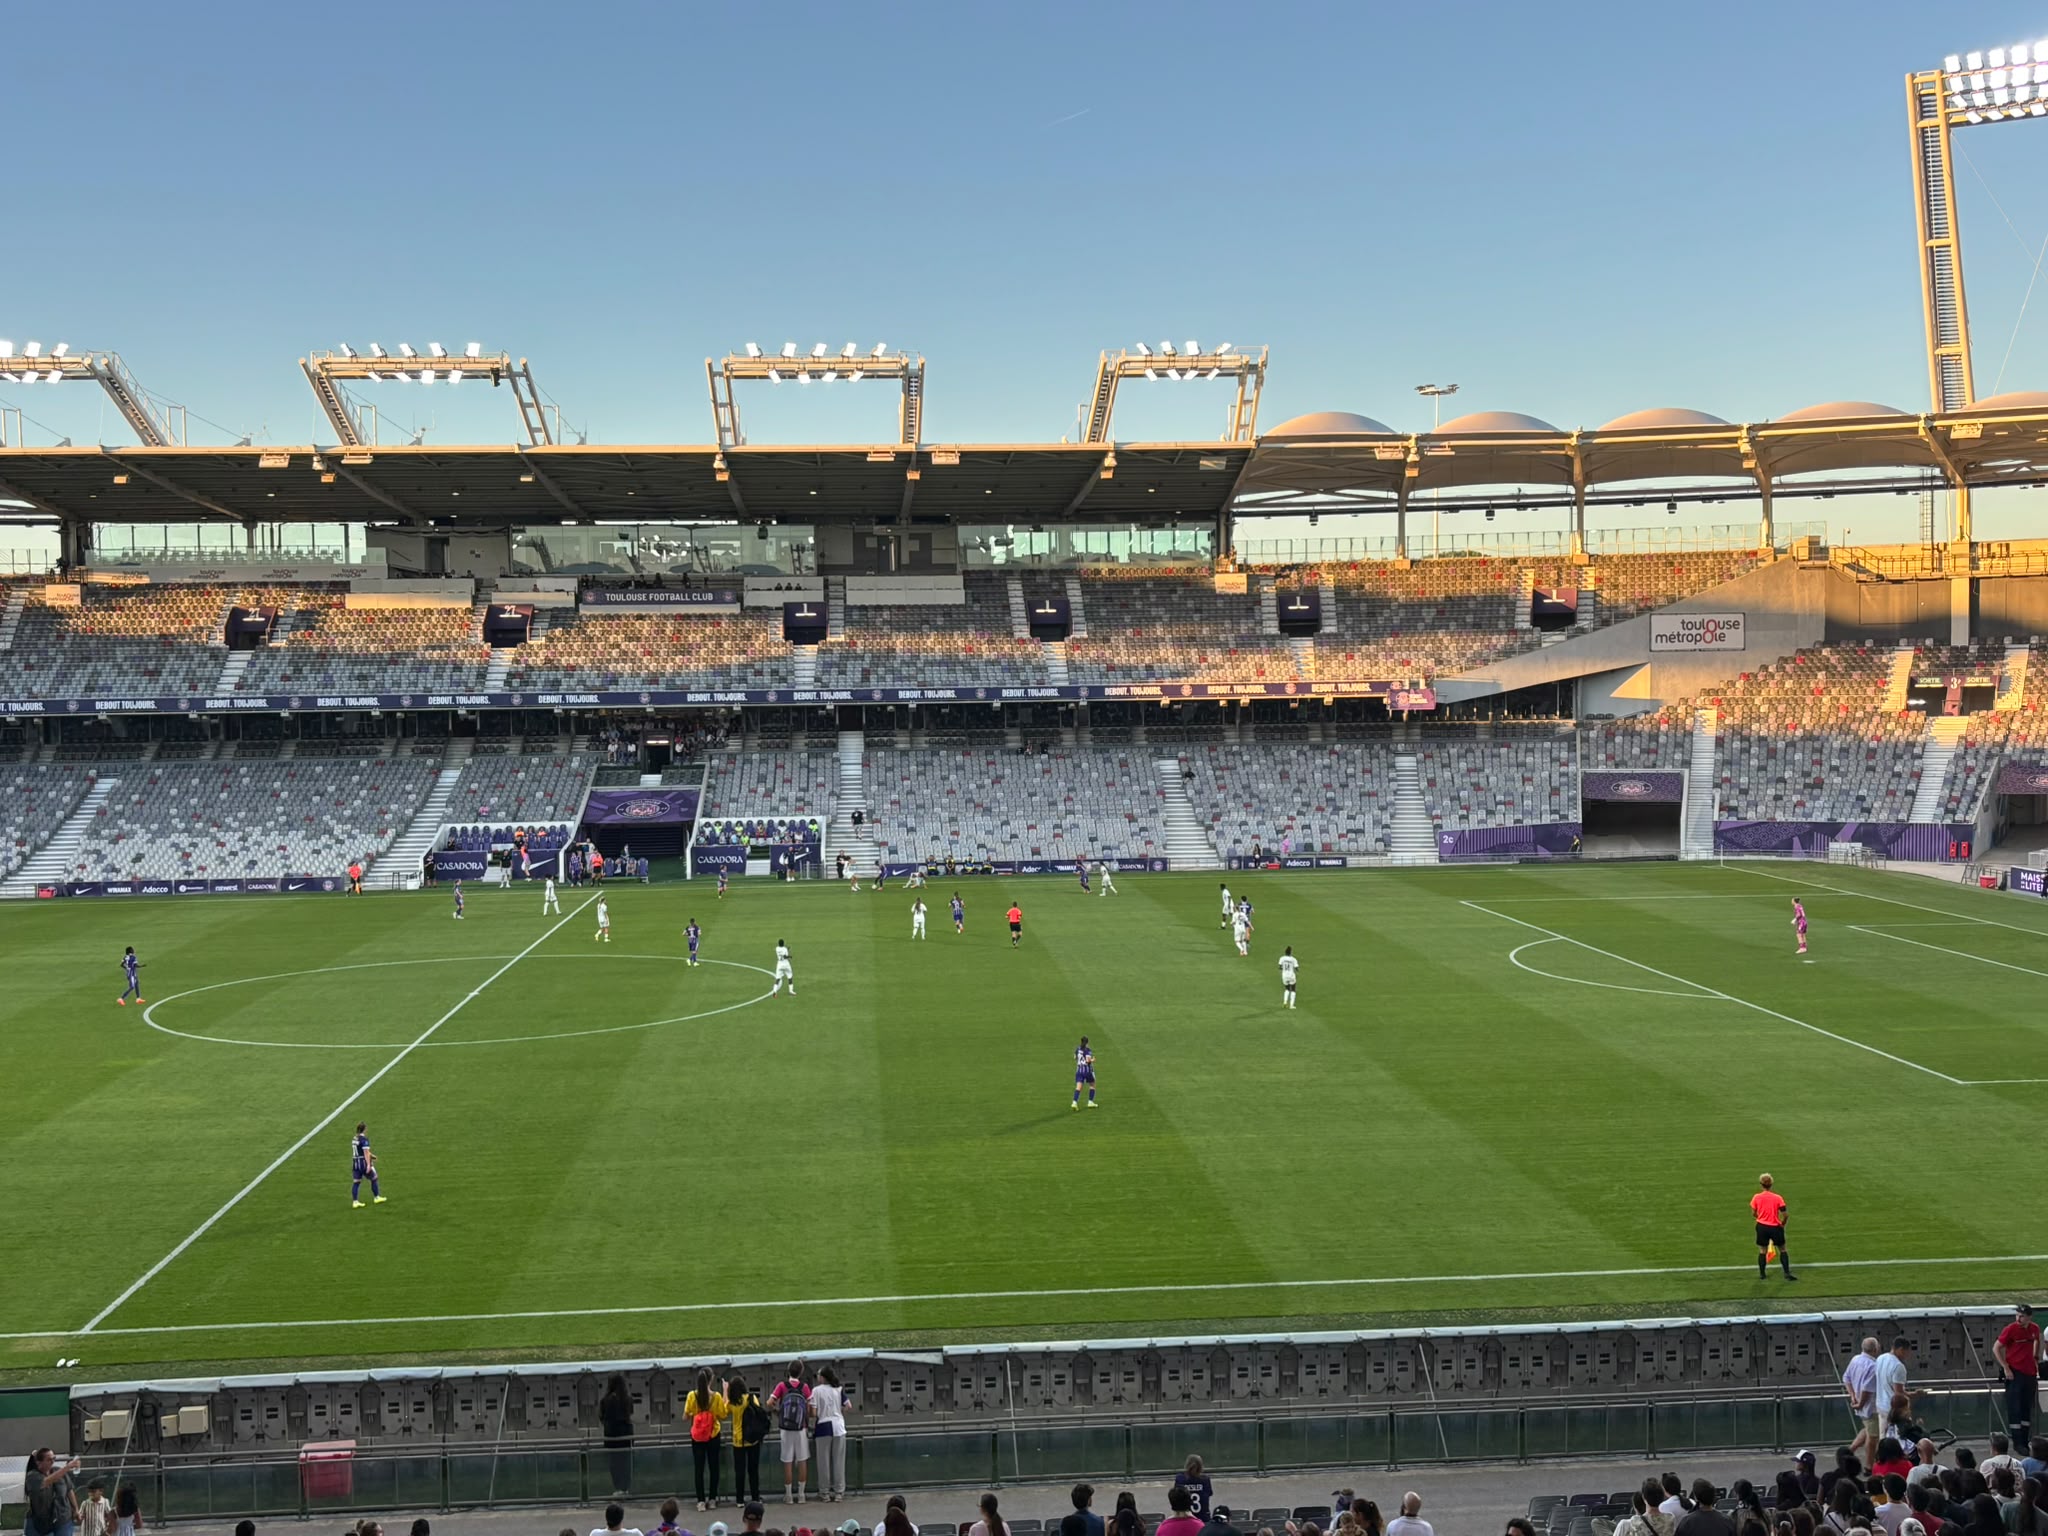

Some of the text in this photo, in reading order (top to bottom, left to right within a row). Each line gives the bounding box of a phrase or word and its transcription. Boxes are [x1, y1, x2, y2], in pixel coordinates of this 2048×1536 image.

[605, 593, 713, 601] TOULOUSE FOOTBALL CLUB
[1681, 618, 1740, 632] toulouse
[1655, 630, 1726, 645] métropole
[1443, 835, 1454, 843] 2c
[697, 855, 743, 864] CASADORA
[437, 862, 484, 871] CASADORA
[1190, 1493, 1201, 1513] 3
